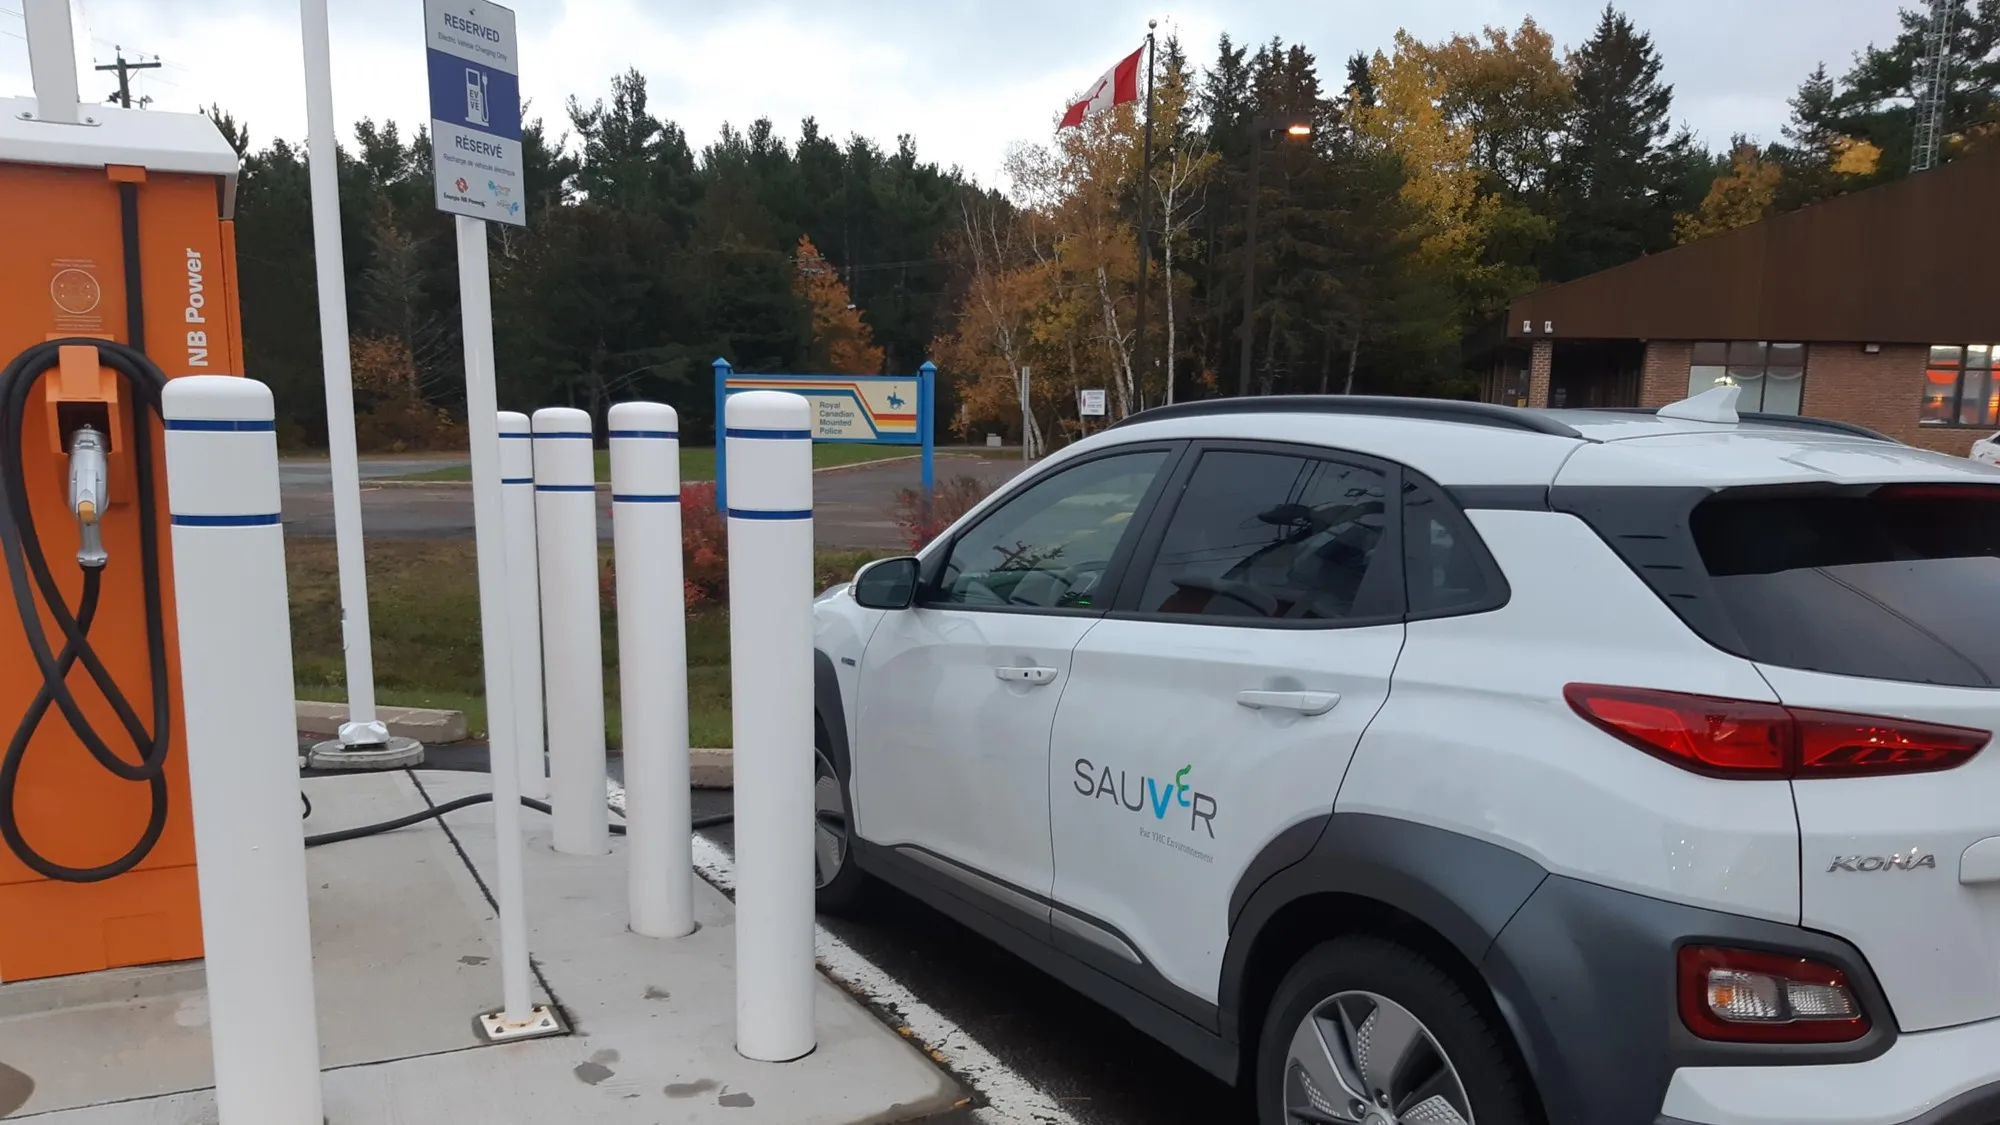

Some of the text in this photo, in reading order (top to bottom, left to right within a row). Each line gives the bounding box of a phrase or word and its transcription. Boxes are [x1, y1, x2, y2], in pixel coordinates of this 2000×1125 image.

[444, 13, 500, 42] RESERVED
[438, 32, 507, 62] Electric Vehicle Charging Only
[469, 90, 479, 99] EV
[470, 101, 480, 111] VE
[455, 135, 503, 159] RÉSERVÉ
[443, 153, 466, 165] Recharge
[186, 248, 208, 367] NB Power
[819, 401, 841, 409] Royal
[819, 410, 854, 418] Canadian
[819, 427, 842, 435] Police
[1139, 826, 1151, 838] Par
[1826, 853, 1936, 873] KONA
